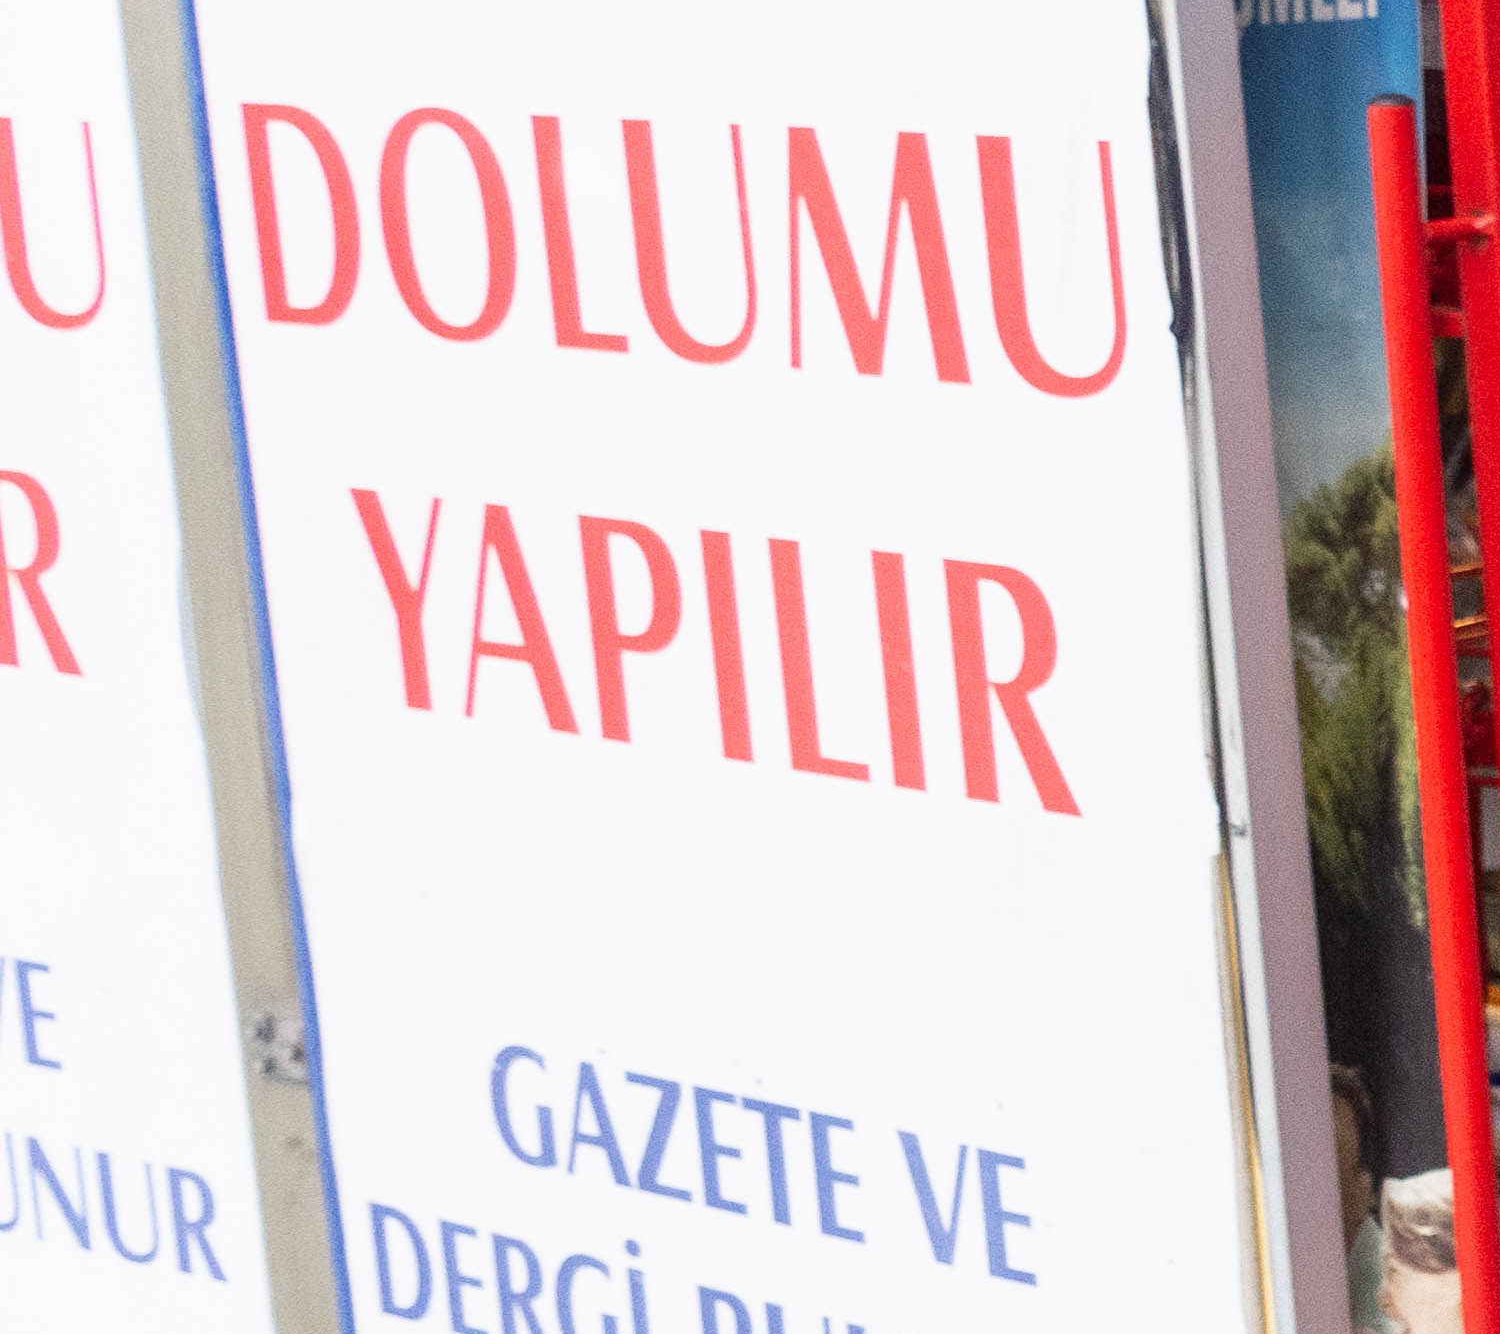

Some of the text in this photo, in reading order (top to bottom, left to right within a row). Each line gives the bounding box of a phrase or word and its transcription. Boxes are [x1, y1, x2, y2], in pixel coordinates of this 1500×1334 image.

[241, 101, 1130, 399] DOLUMU
[349, 487, 1084, 818] YAPILIR
[489, 1044, 1040, 1287] GAZETE VE
